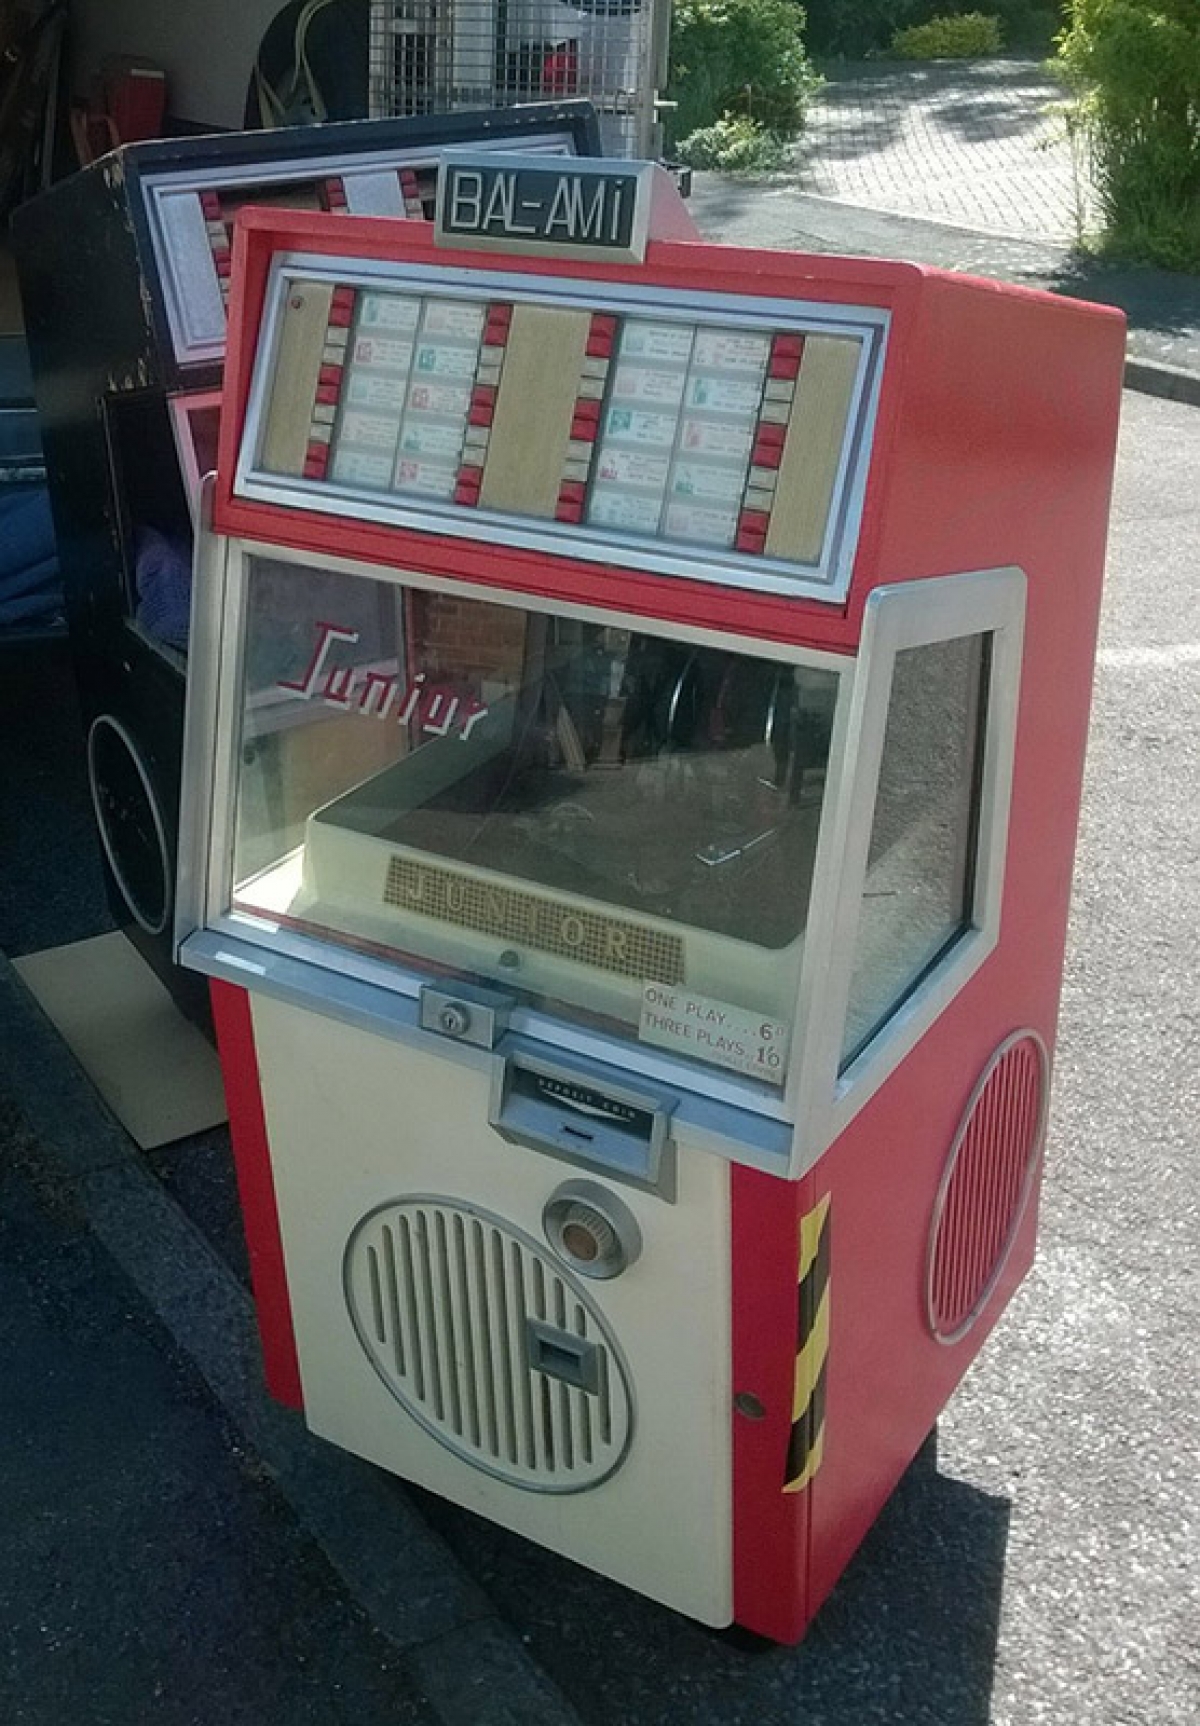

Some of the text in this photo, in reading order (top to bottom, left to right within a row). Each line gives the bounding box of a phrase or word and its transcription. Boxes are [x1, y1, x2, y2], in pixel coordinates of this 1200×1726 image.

[275, 620, 489, 741] Junior
[406, 866, 627, 958] JUNIOR
[643, 1011, 691, 1038] THREE
[645, 987, 677, 1010] ONE
